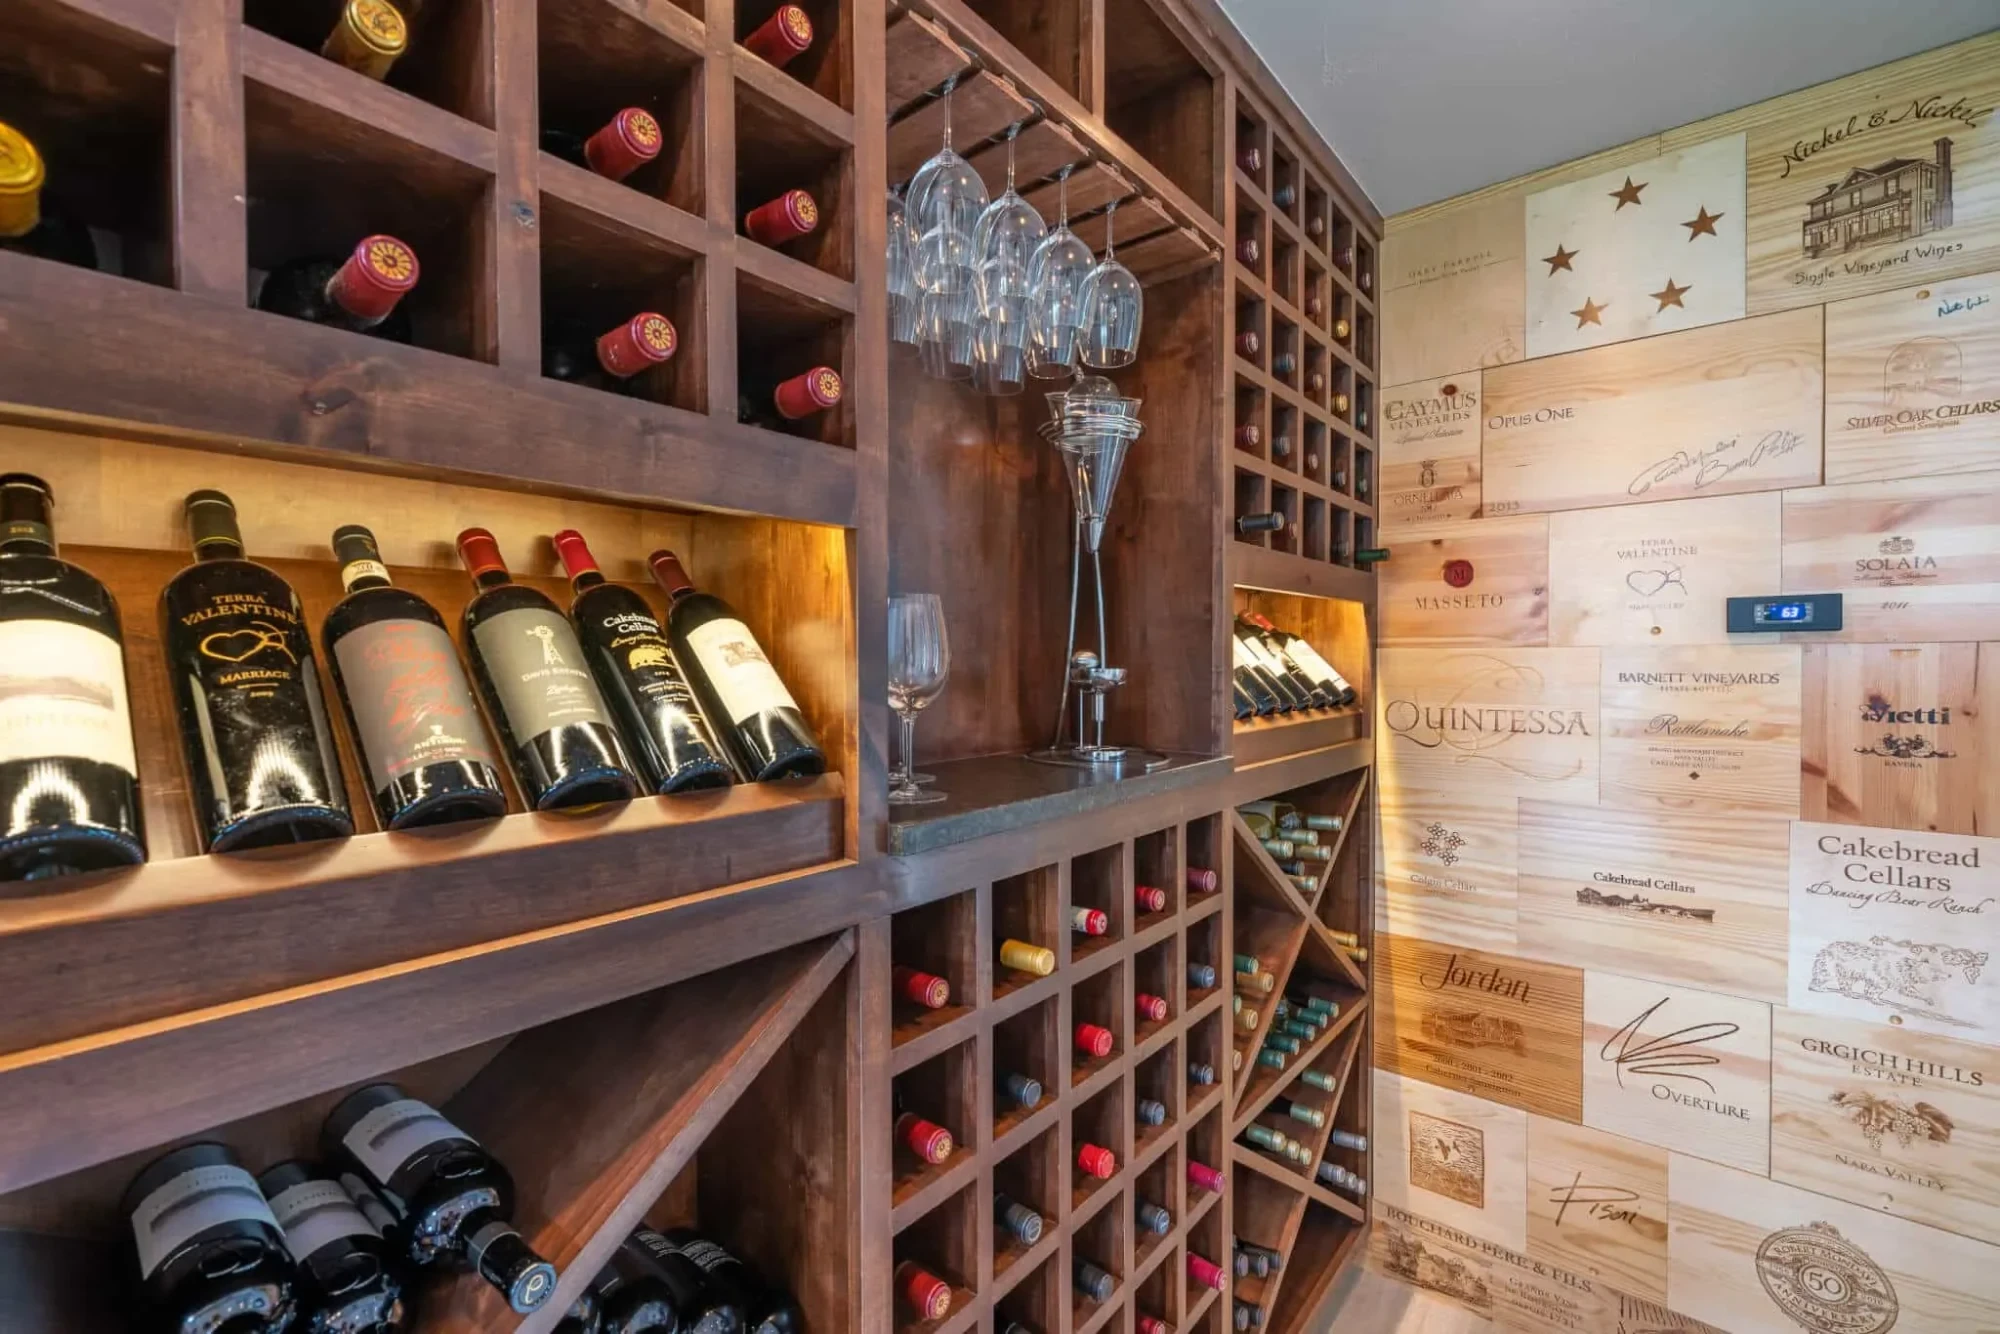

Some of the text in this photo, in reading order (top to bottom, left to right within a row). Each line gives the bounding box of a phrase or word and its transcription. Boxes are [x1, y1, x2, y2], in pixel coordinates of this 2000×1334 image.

[1781, 116, 1863, 178] Nickel
[1889, 95, 1995, 129] Nickel
[1794, 243, 1963, 286] Single Vineyard Wines
[1385, 391, 1476, 421] CAYMUS
[1845, 400, 2000, 430] SILVER OAK CELLARS
[1390, 411, 1470, 431] VINEYARDS
[1617, 546, 1698, 560] VALENTINE
[1856, 555, 1937, 572] SOLAIA
[211, 594, 265, 604] TERRA
[1415, 593, 1503, 610] MASSETO
[181, 604, 297, 626] VALENTINE
[1782, 607, 1799, 618] 63
[219, 671, 291, 685] MARRIAGE
[1618, 672, 1780, 687] BARNETT VINEYARDS
[1385, 700, 1591, 748] QUINTESSA
[1644, 713, 1750, 737] Rattlesnake
[1818, 835, 1981, 868] Cakebread
[1593, 871, 1696, 893] Cakebread Cellars
[1844, 863, 1952, 892] Cellars
[1806, 880, 1996, 915] Dancing Bear Ranch
[1420, 953, 1530, 1003] Jordan
[1801, 1038, 1984, 1086] GRGICH HILLS
[1852, 1064, 1923, 1088] ESTATE
[1652, 1084, 1750, 1121] OVERTURE
[1549, 1171, 1641, 1227] Pisoni
[1386, 1206, 1478, 1249] BOUCHARD
[1532, 1261, 1546, 1276] &
[1552, 1268, 1593, 1293] FILS
[1808, 1271, 1842, 1295] 50
